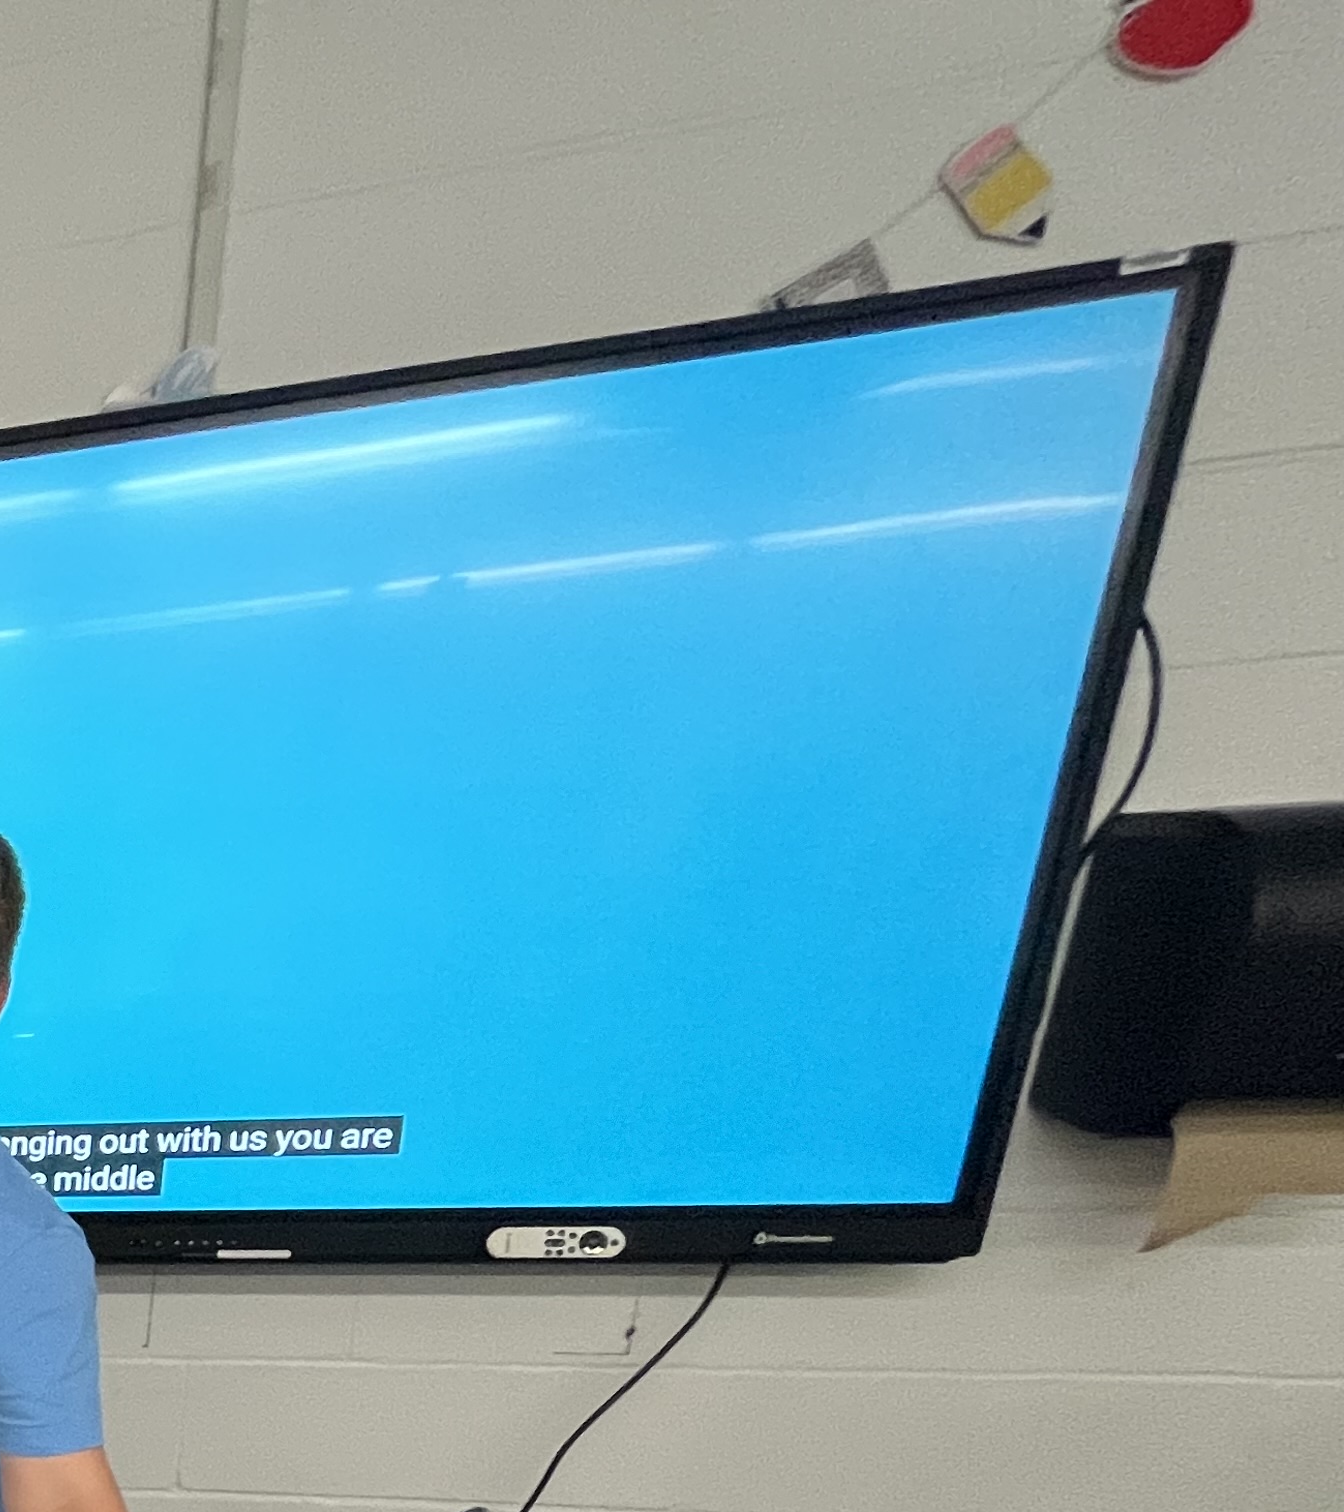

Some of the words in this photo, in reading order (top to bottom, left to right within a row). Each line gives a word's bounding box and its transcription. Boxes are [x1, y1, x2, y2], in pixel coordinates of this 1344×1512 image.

[98, 1131, 150, 1155] out
[158, 1124, 222, 1155] with
[229, 1130, 268, 1153] us
[273, 1128, 334, 1157] you
[339, 1126, 395, 1150] are
[52, 1164, 156, 1193] middle
